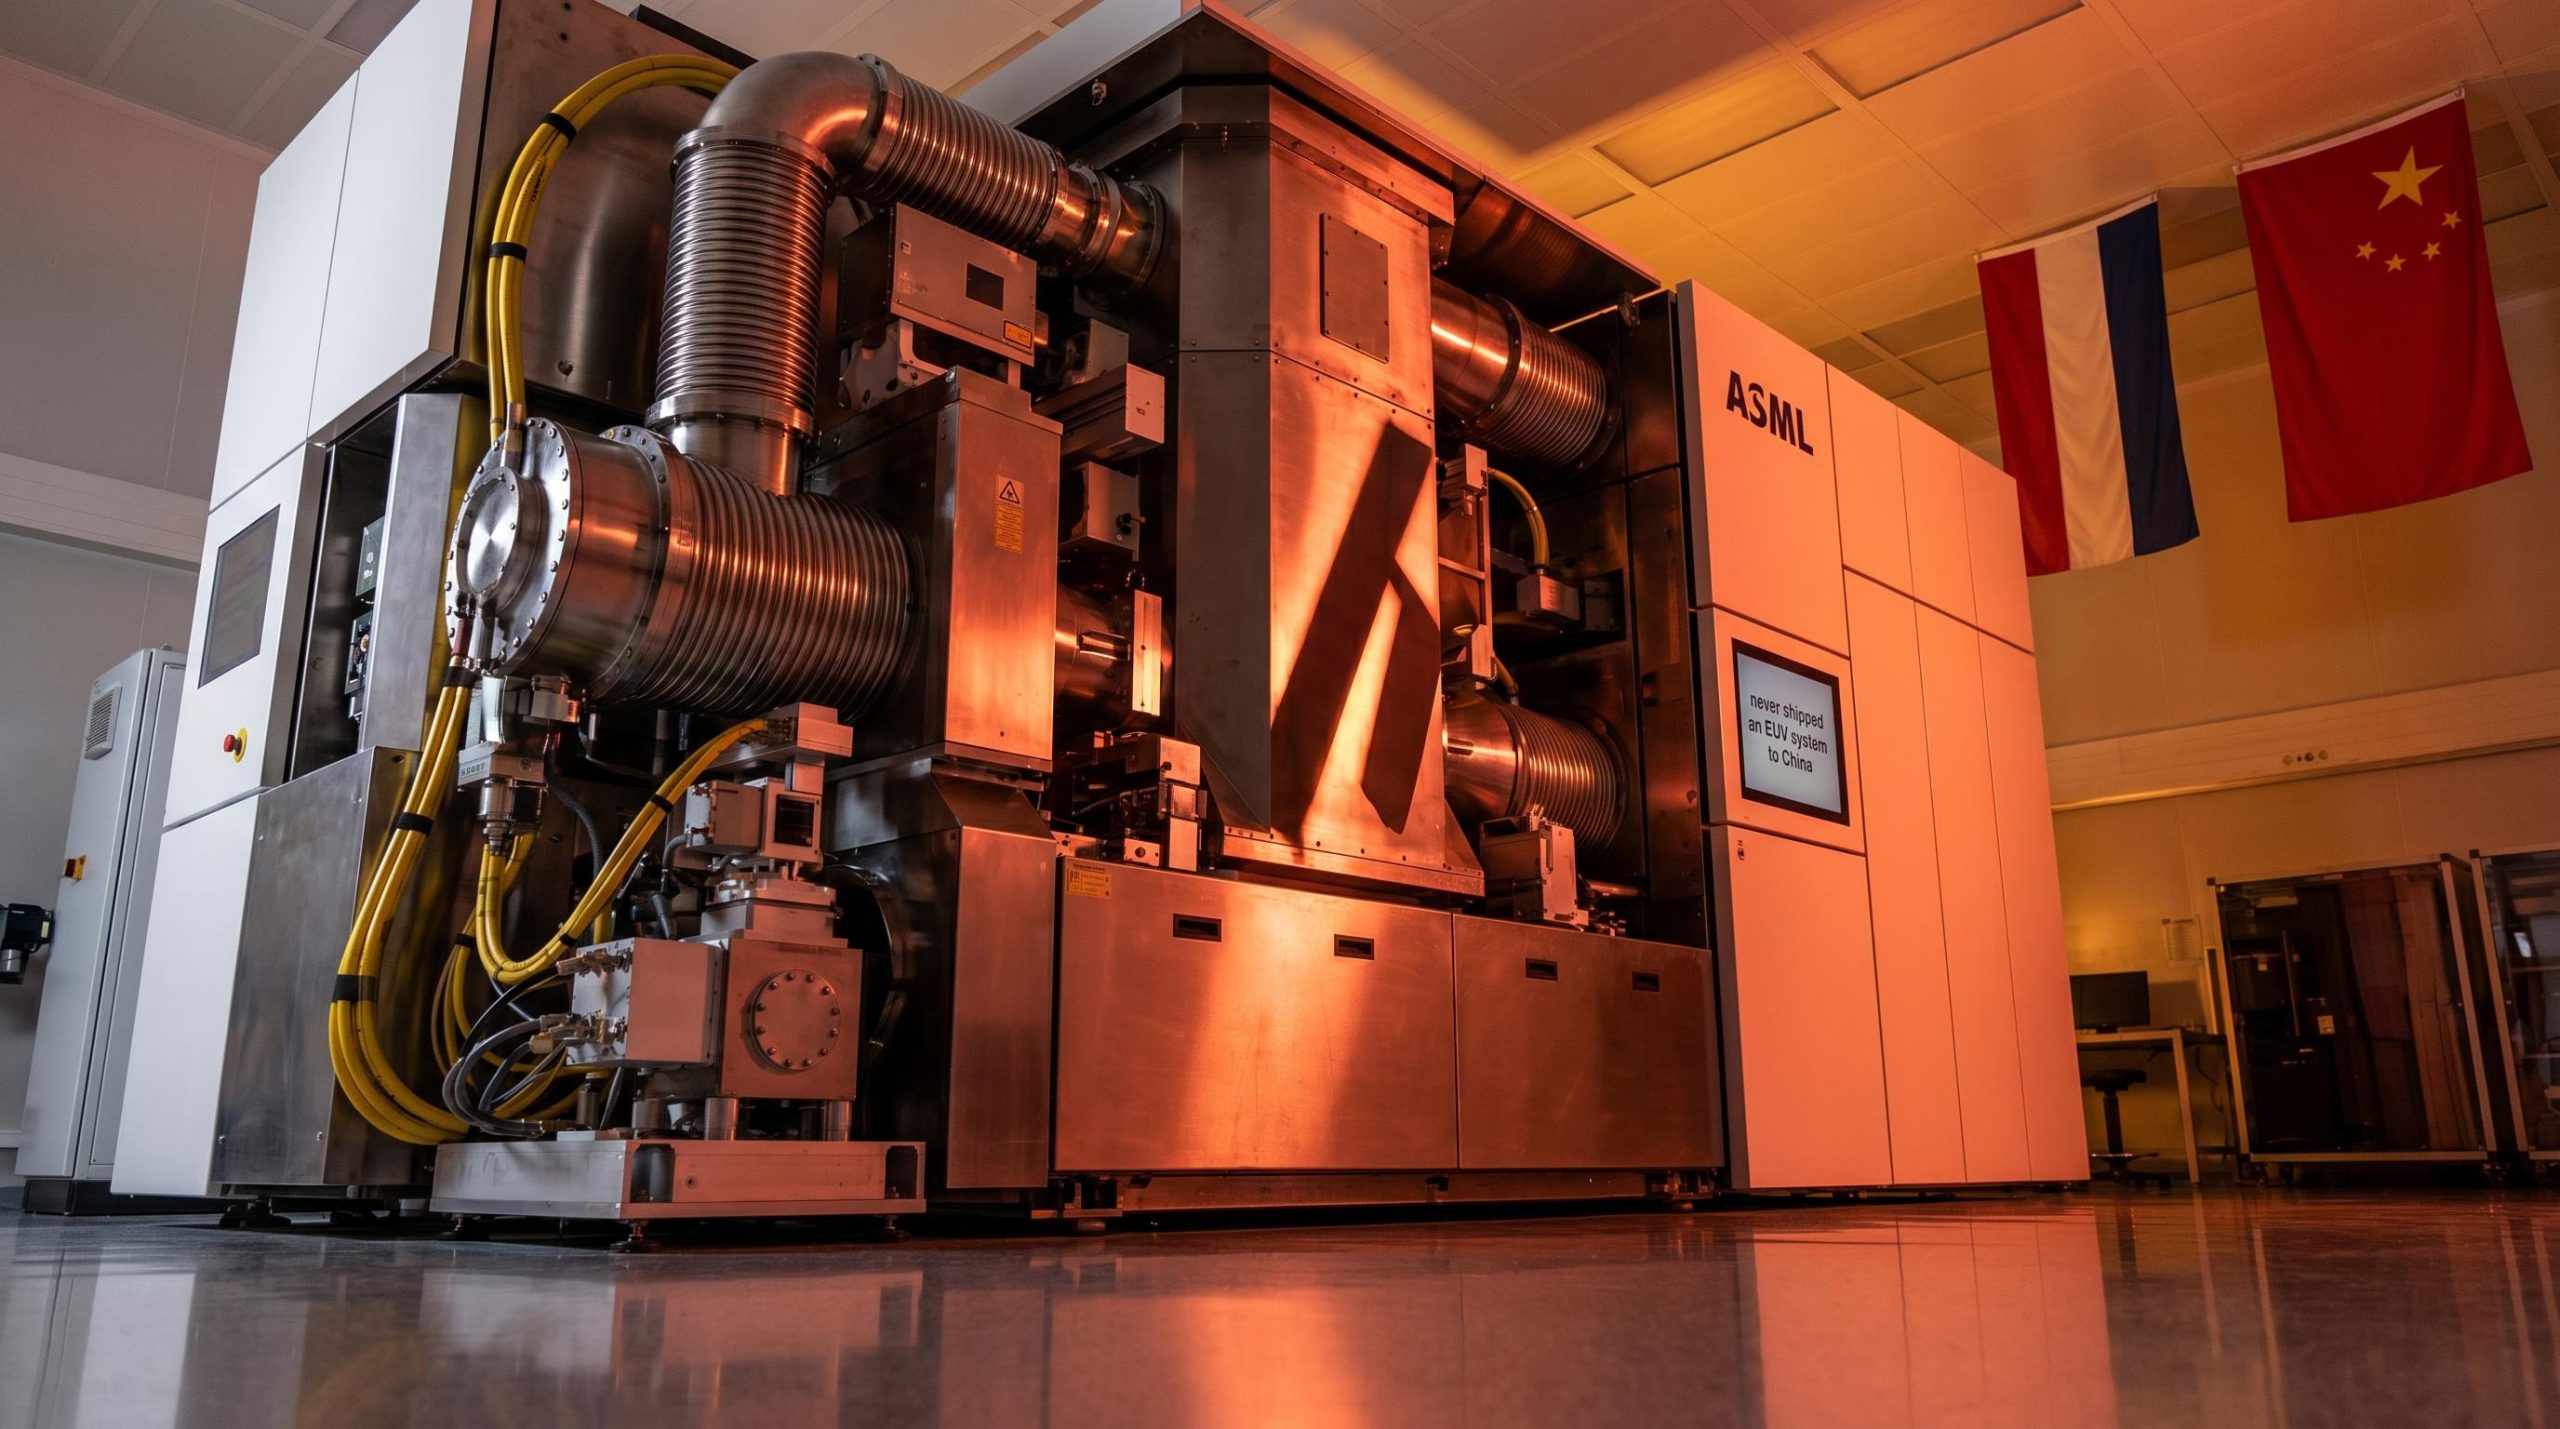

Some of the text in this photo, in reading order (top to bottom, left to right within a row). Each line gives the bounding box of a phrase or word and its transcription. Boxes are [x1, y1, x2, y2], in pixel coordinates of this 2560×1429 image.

[1726, 370, 1814, 456] ASML
[1750, 694, 1824, 729] never shipped
[1749, 718, 1828, 754] an EUV system
[1768, 746, 1813, 773] to China
